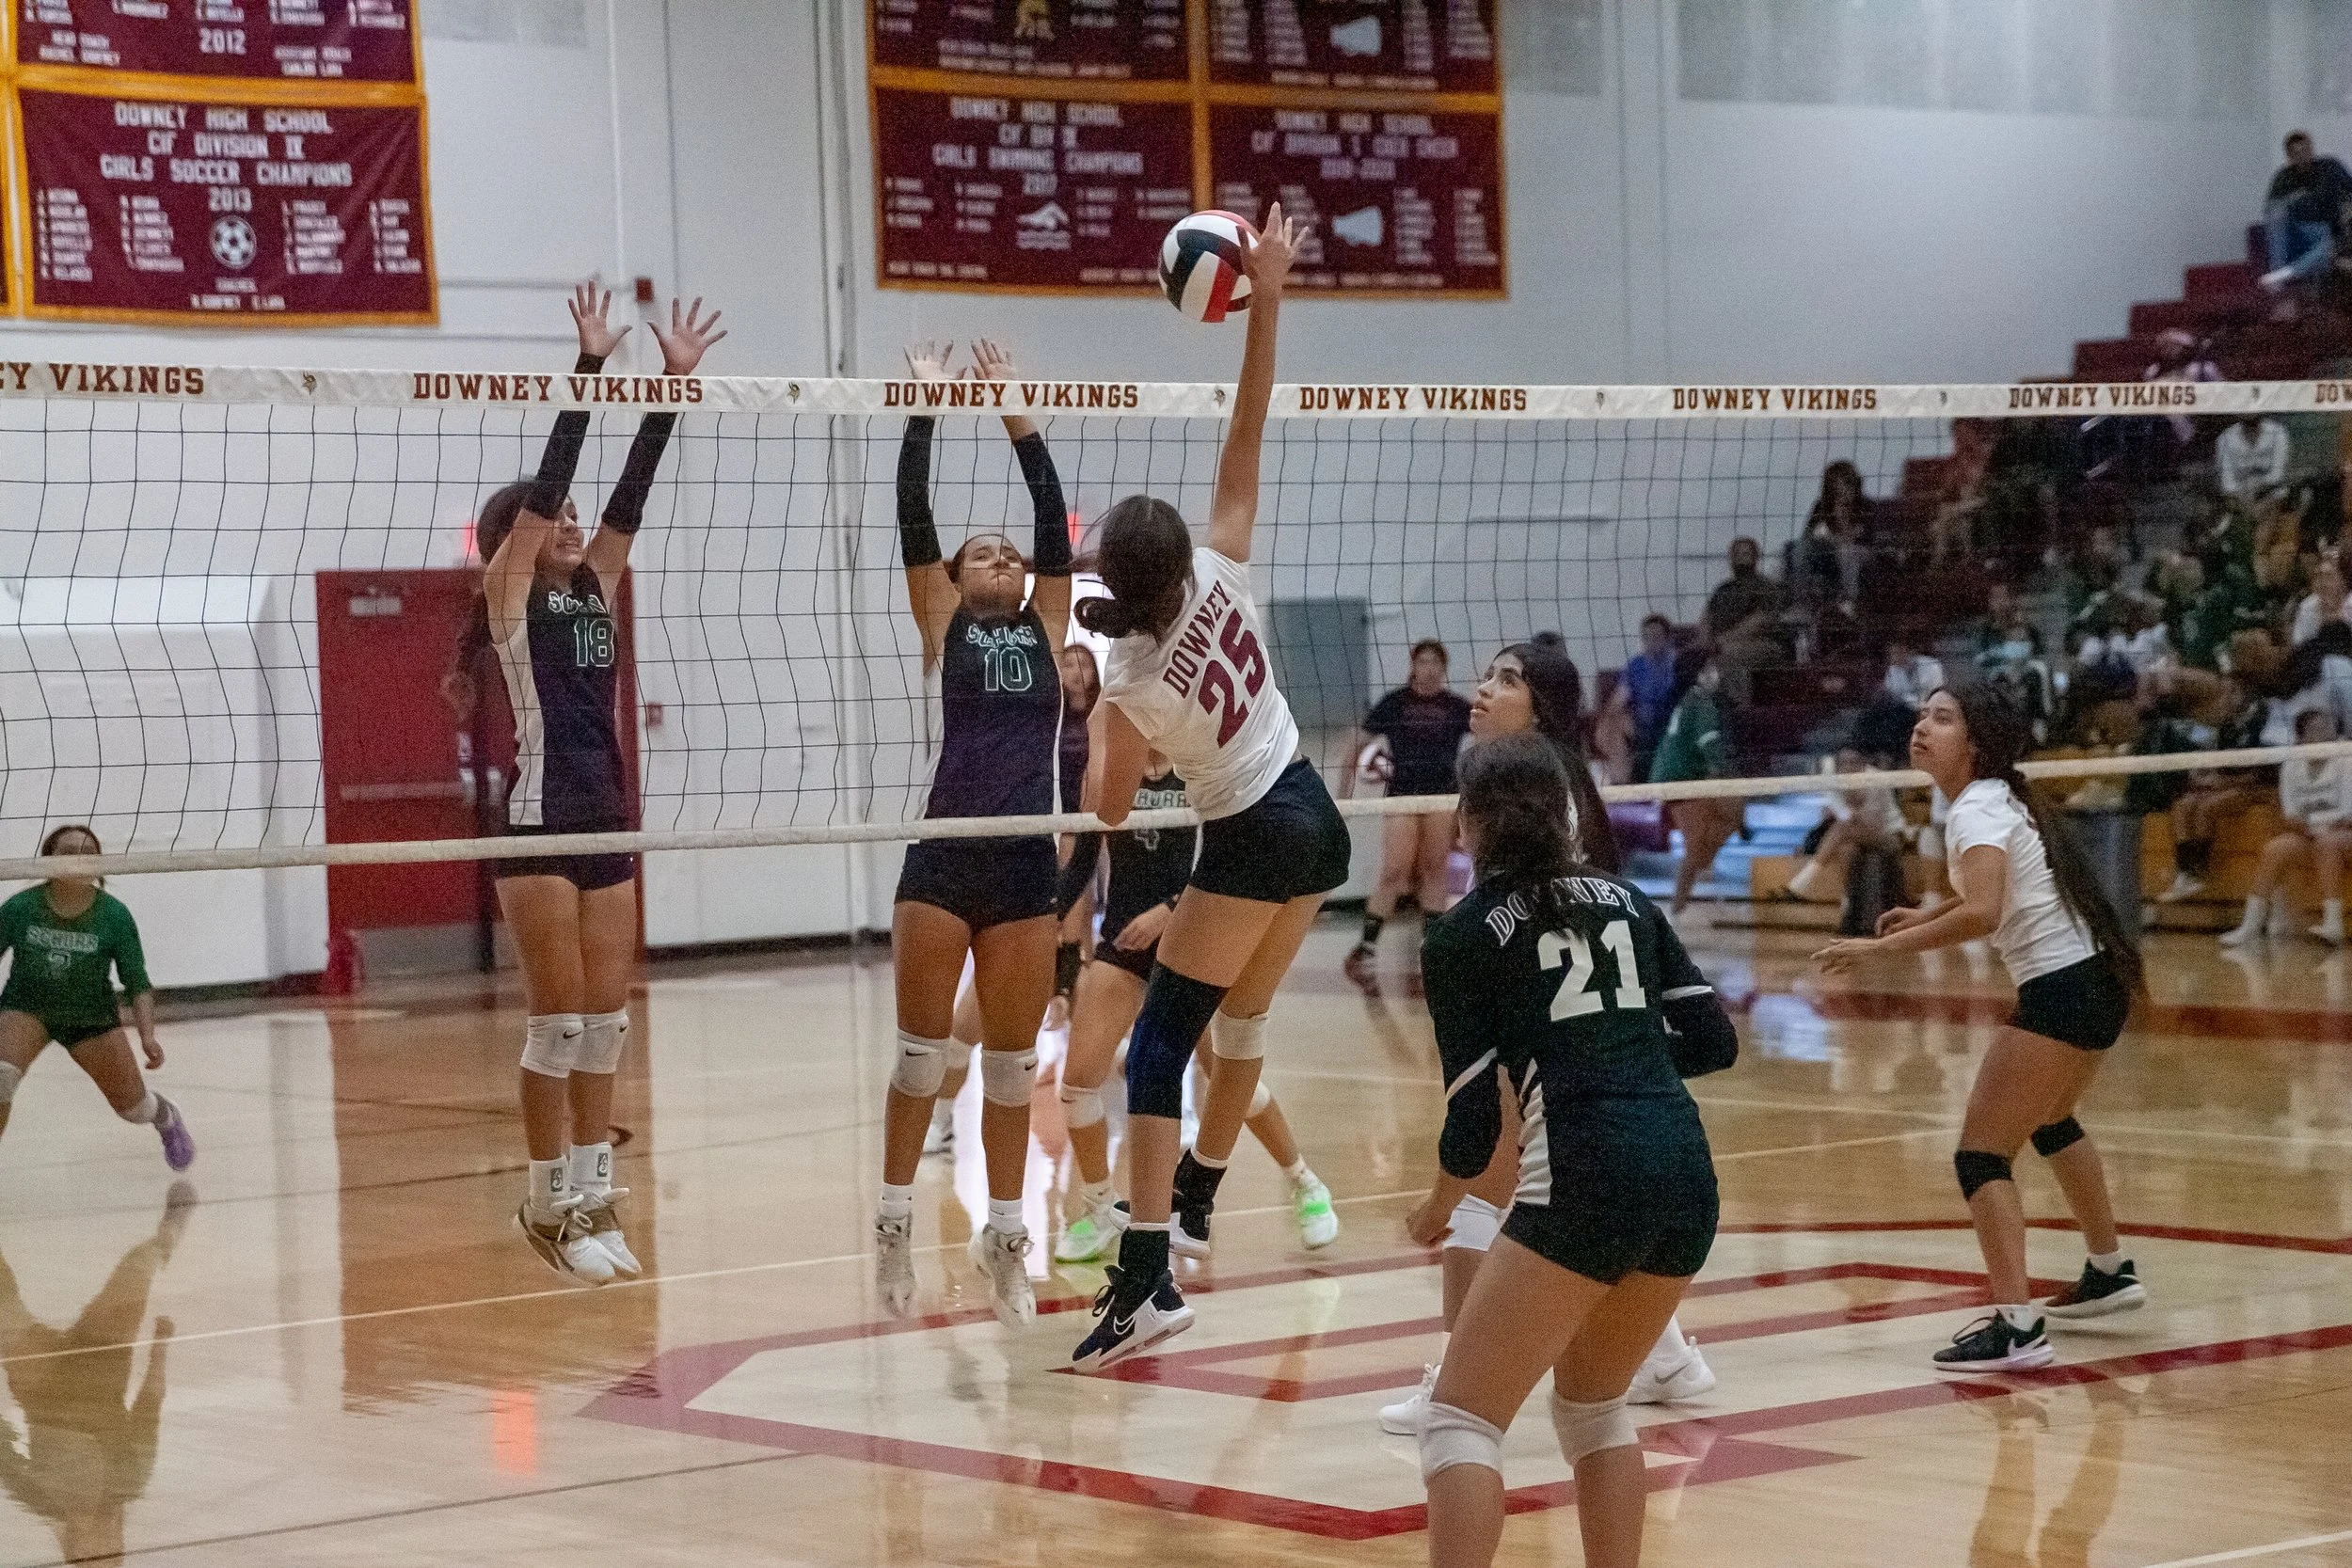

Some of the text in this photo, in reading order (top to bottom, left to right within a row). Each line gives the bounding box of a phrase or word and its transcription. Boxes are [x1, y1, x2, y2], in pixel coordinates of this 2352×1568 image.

[199, 30, 246, 55] 2012
[115, 102, 333, 134] DOWNEY HIGH SCHOOL
[194, 132, 269, 158] DIVISION
[100, 153, 353, 186] GIRLS SOCCER CHAMPIONS
[208, 187, 253, 212] 2013
[0, 362, 205, 395] Y VIKINGS
[413, 372, 704, 404] DOWNEY VIKINGS
[883, 382, 1139, 408] DOWNEY VIKINGS
[1299, 387, 1527, 411] DOWNEY VIKINGS
[1672, 388, 1878, 411] DOWNEY VIKINGS
[2008, 385, 2198, 409] DOWNEY VIKINGS
[574, 618, 614, 668] 18
[1162, 579, 1232, 699] DOWNEY
[984, 646, 1033, 691] 10
[1198, 608, 1266, 749] 25
[1133, 787, 1190, 809] HURR
[1486, 877, 1640, 947] DONEY
[1537, 919, 1647, 1022] 21
